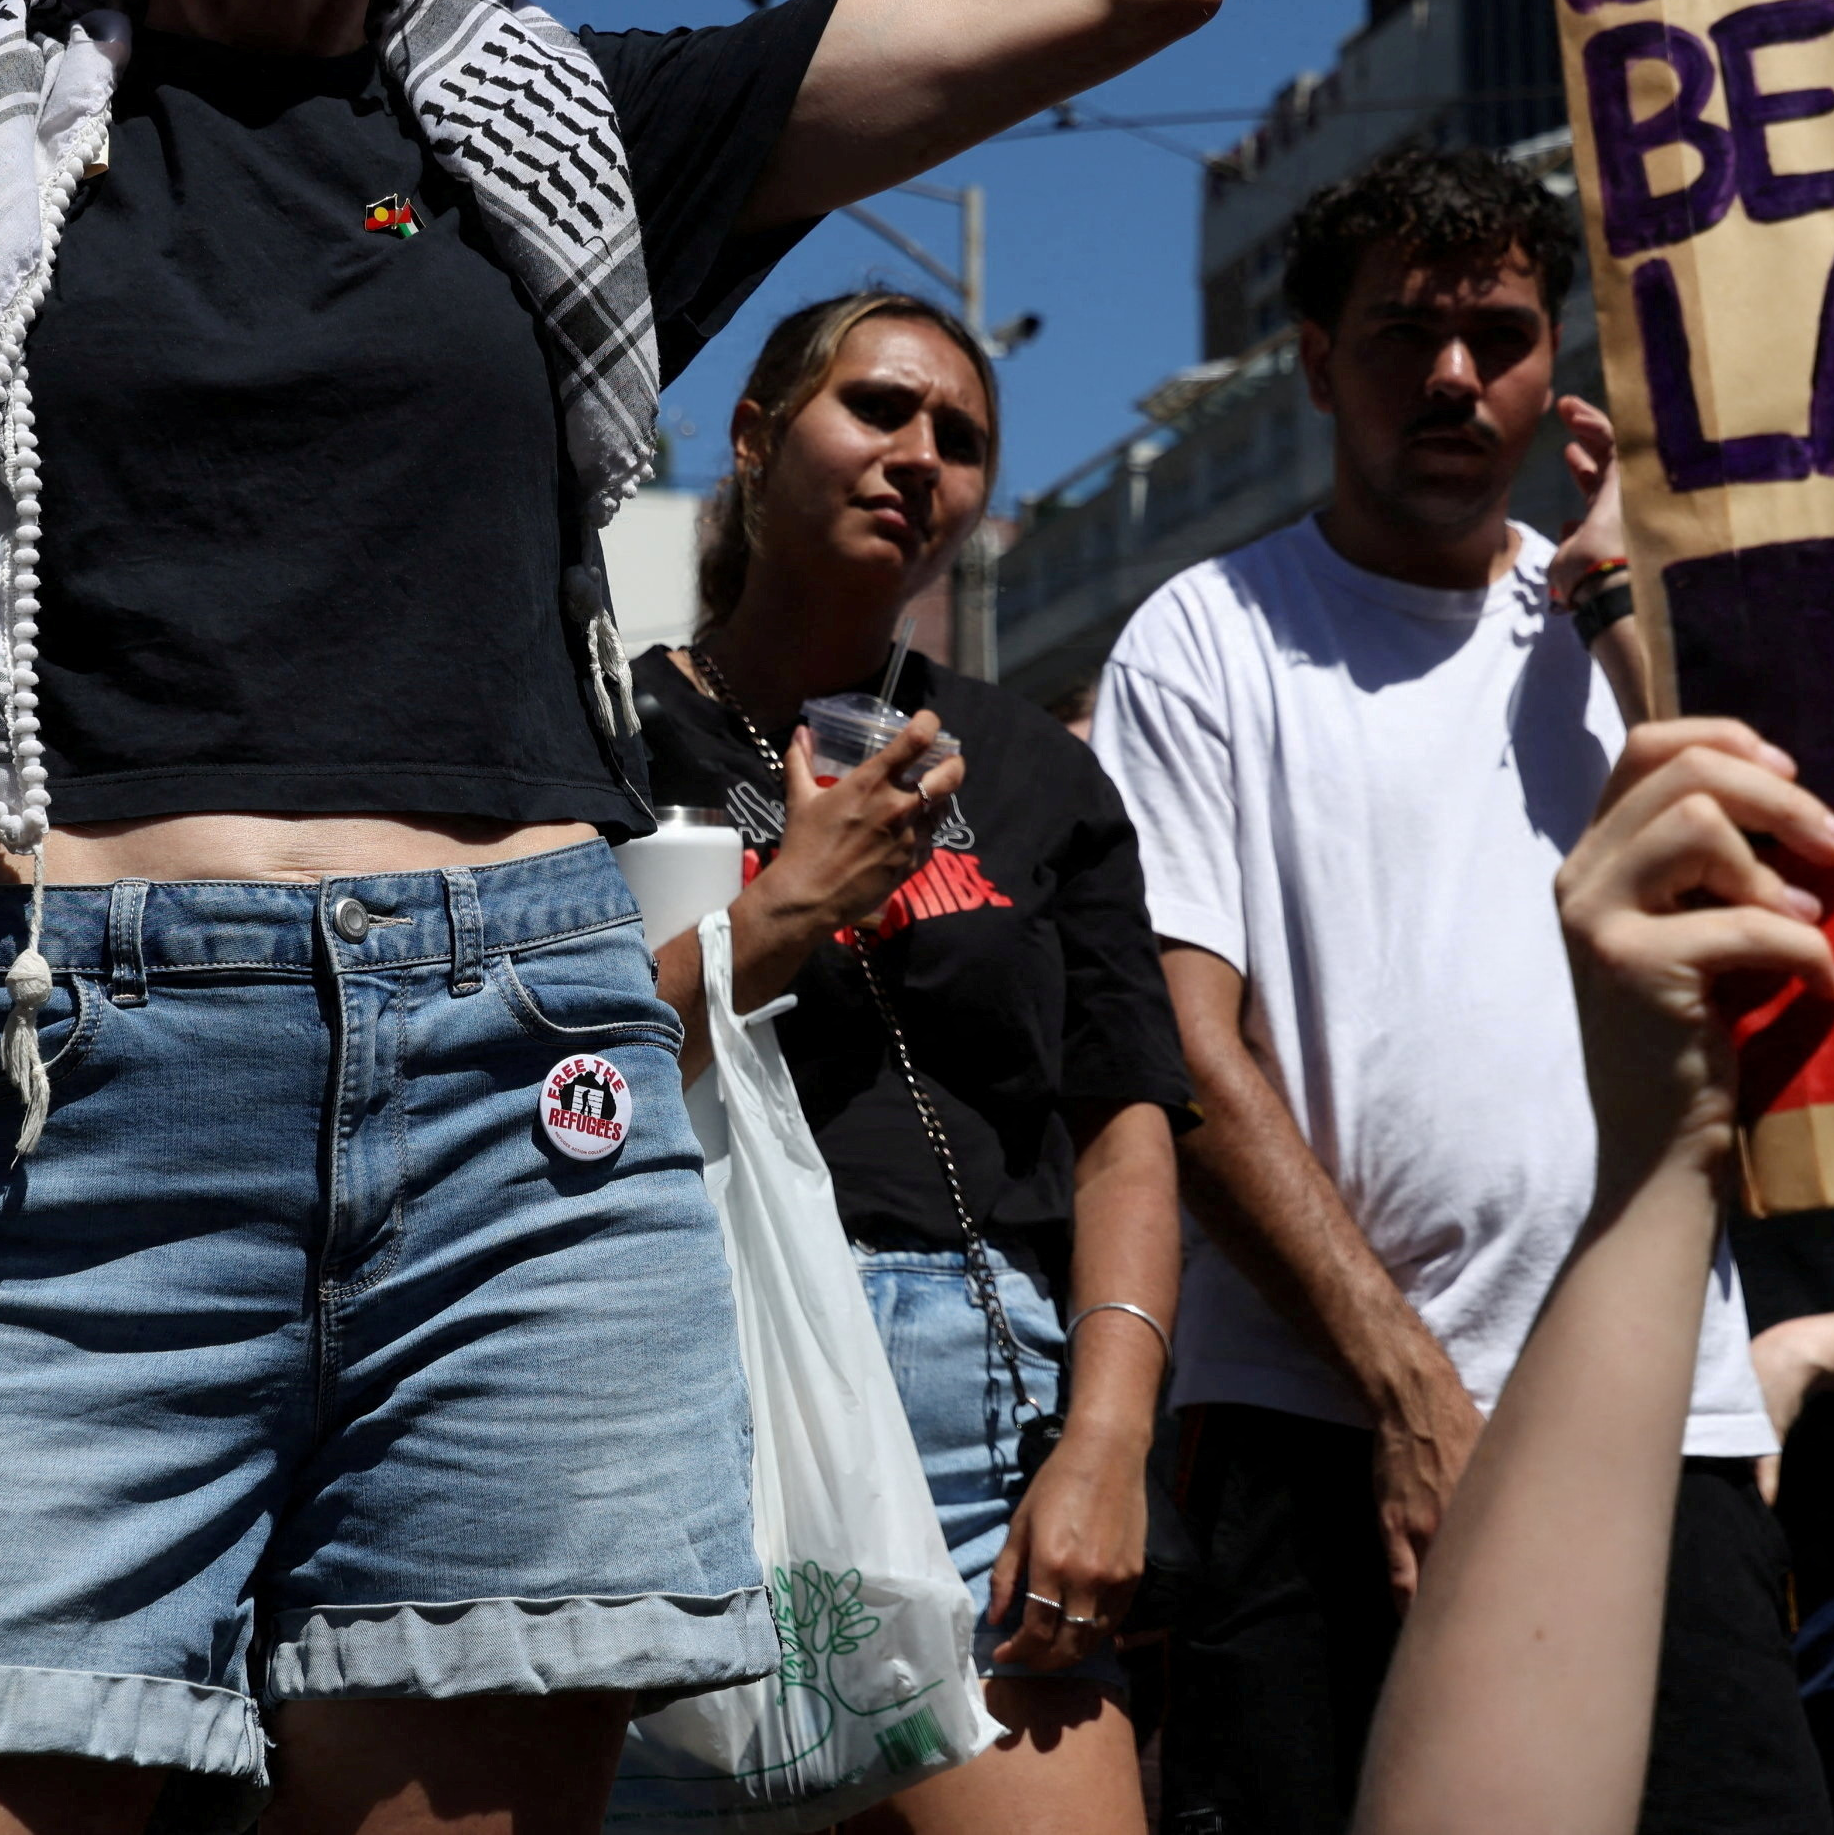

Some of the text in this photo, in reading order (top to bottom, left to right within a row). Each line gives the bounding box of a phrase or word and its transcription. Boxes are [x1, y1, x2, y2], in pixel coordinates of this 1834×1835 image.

[547, 1059, 625, 1101] FREE THE
[548, 1107, 623, 1142] REFUGEES
